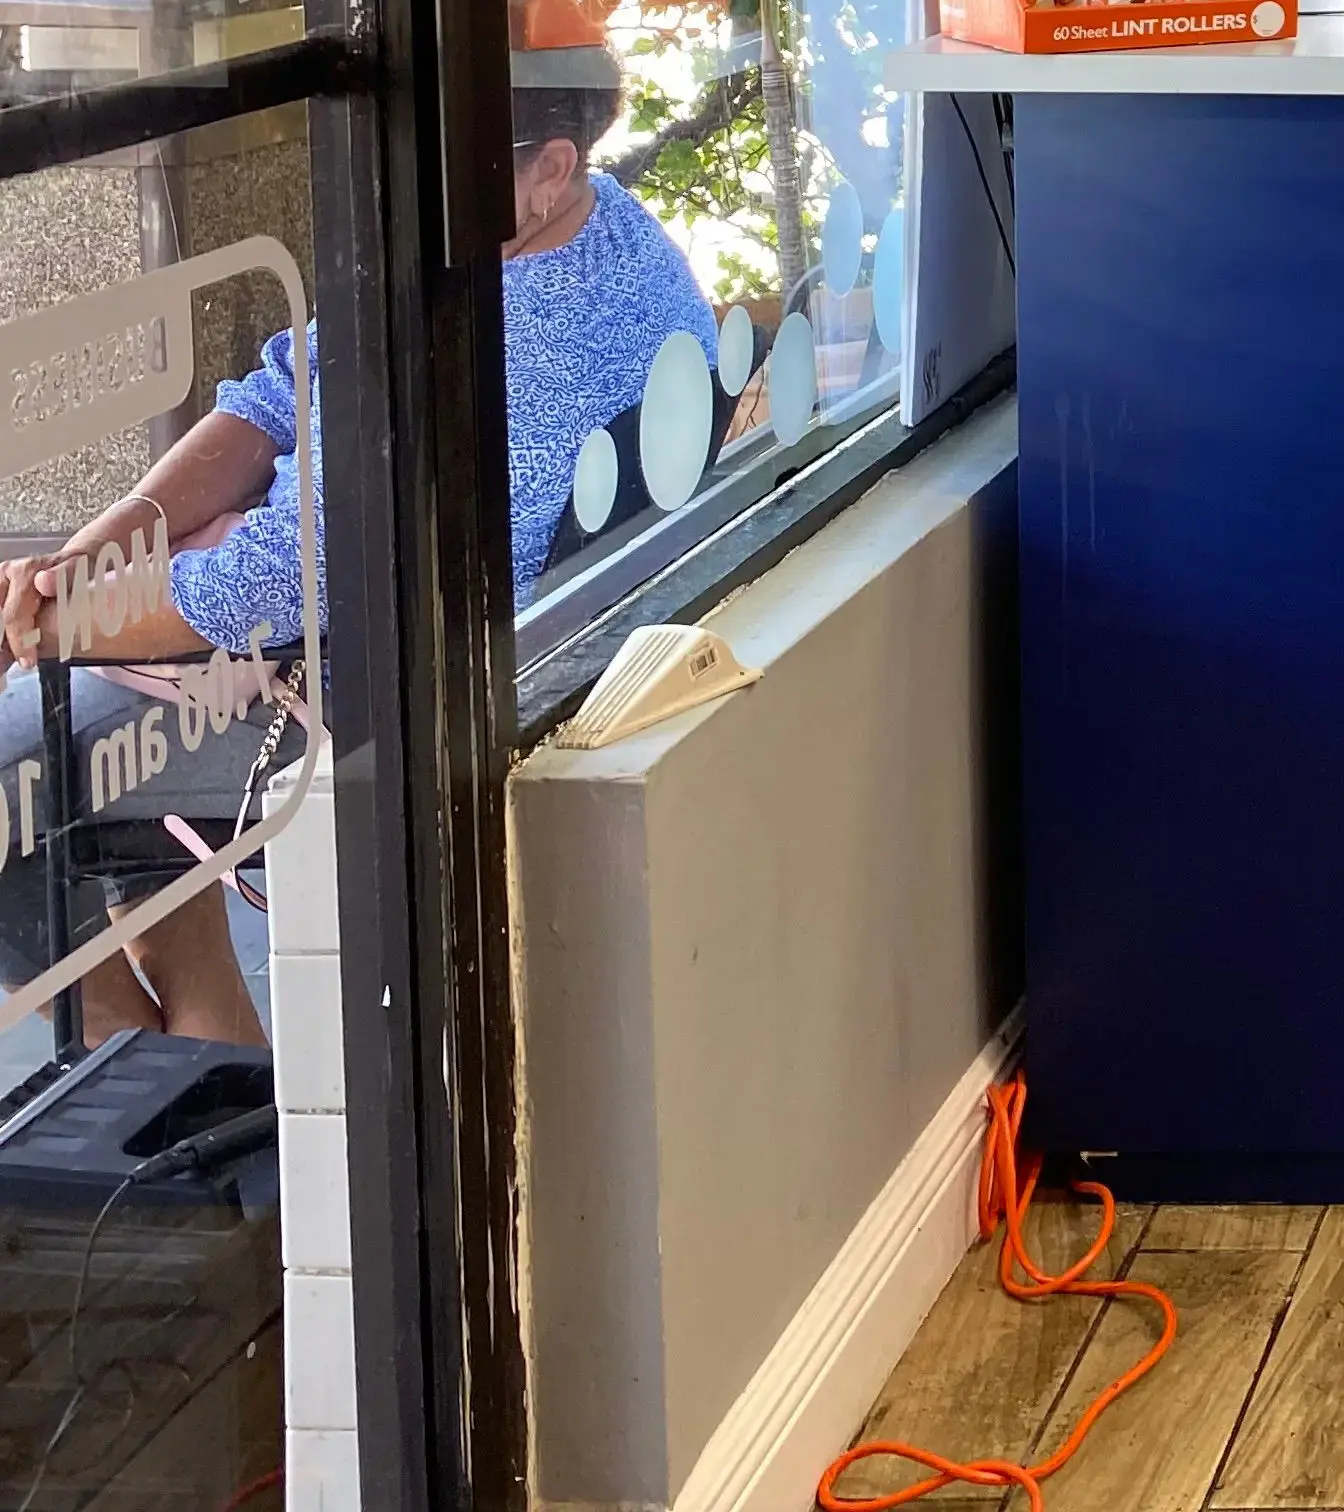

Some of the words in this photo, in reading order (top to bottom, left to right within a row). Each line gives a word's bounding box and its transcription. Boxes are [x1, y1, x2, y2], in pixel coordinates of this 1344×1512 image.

[1054, 26, 1070, 40] 60
[1071, 26, 1108, 39] Sheet
[1112, 19, 1158, 37] LINT
[1162, 13, 1247, 34] ROLLERS
